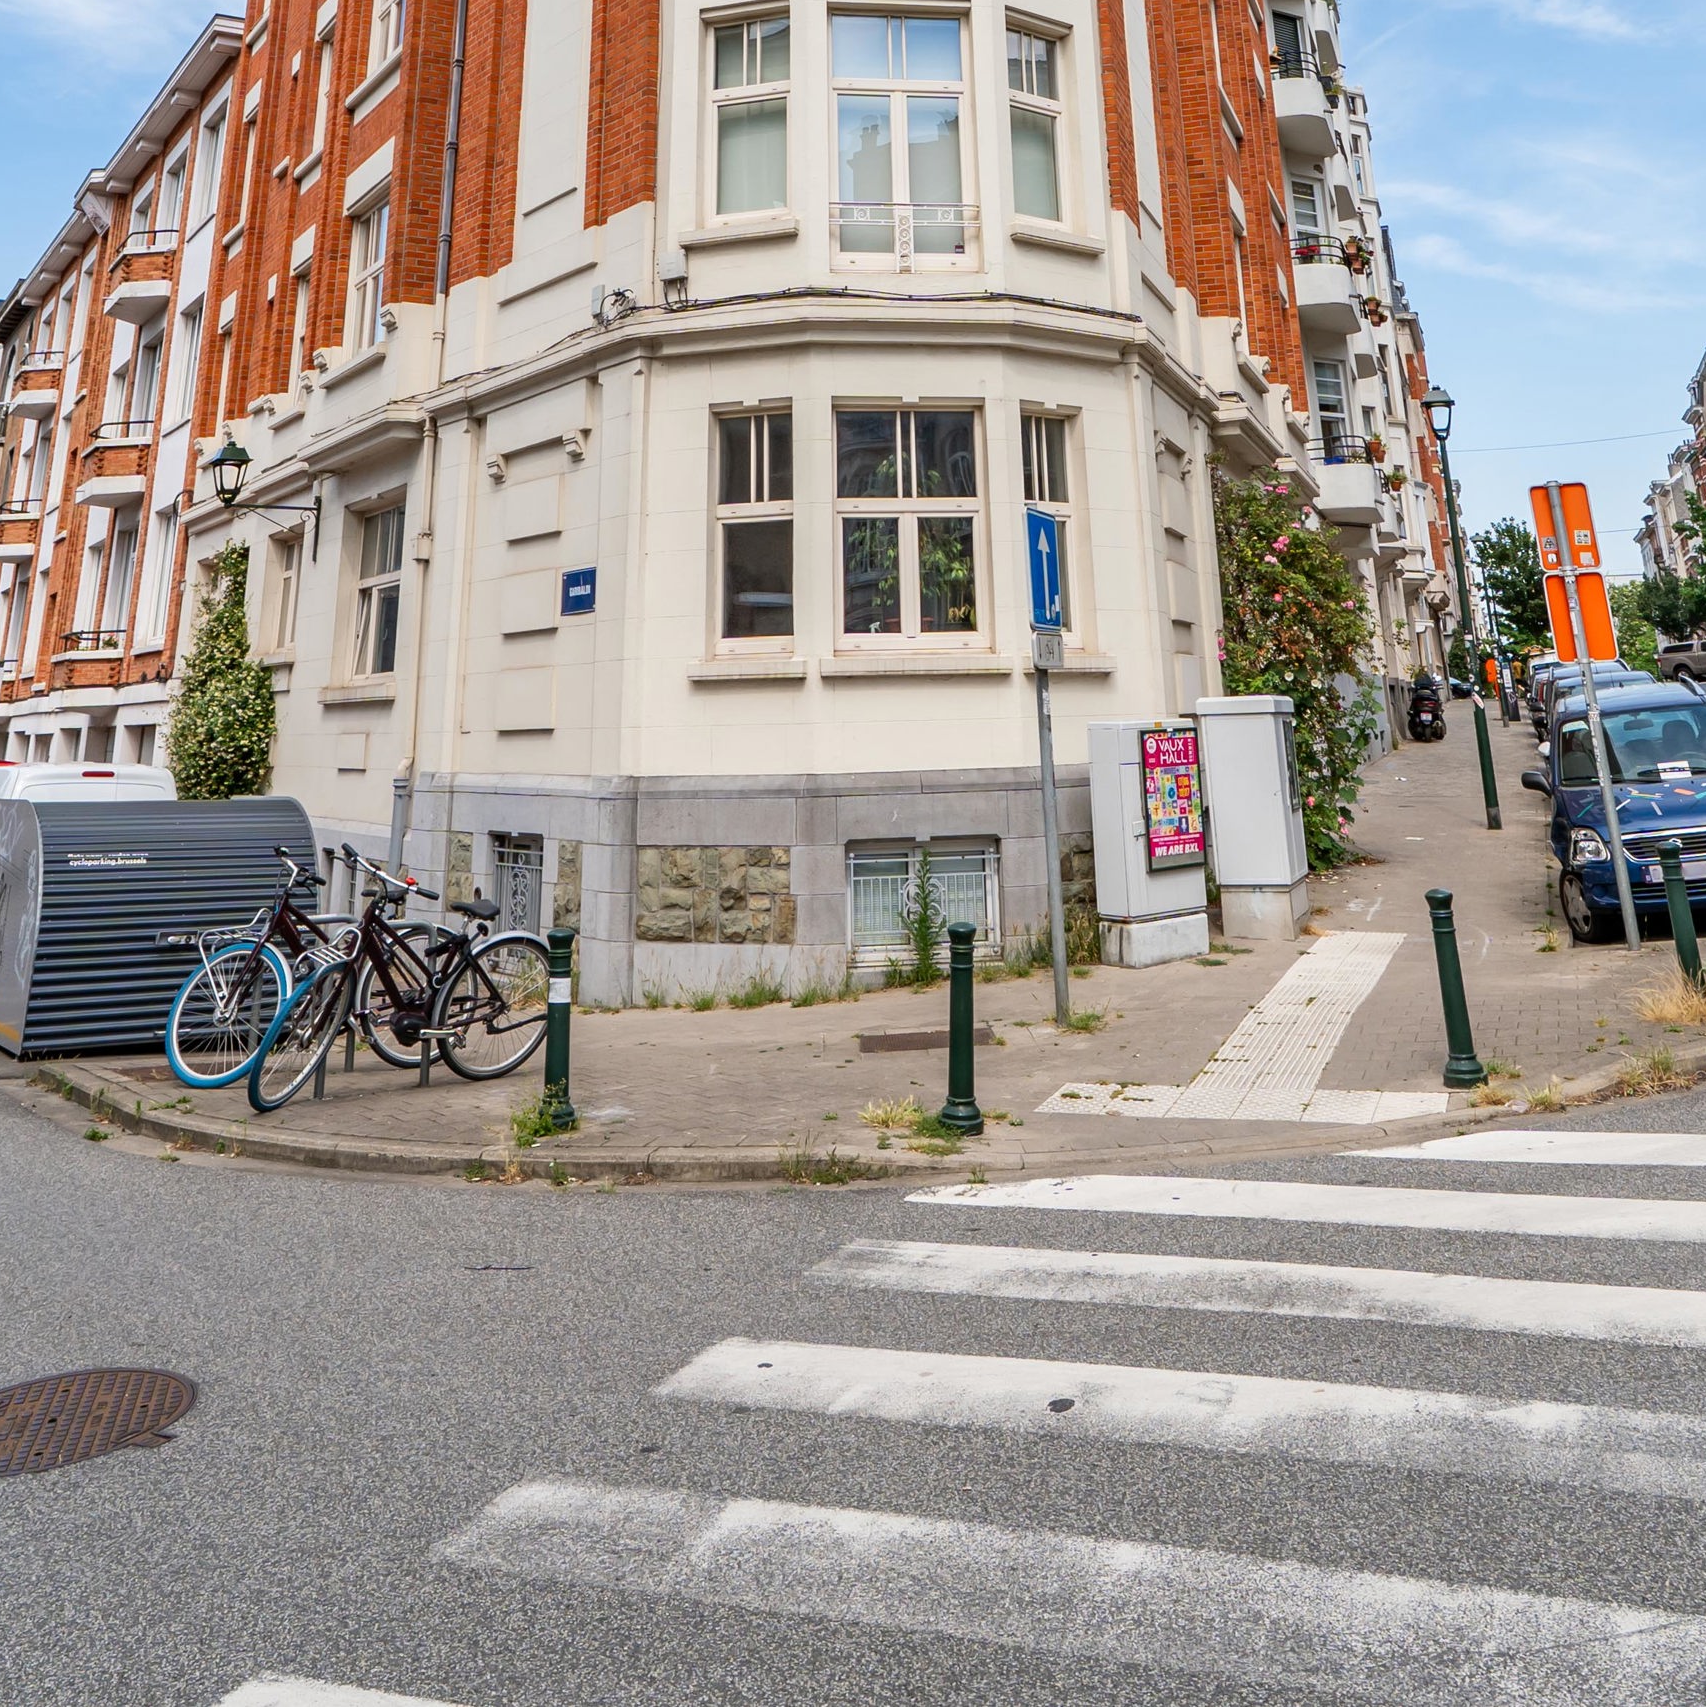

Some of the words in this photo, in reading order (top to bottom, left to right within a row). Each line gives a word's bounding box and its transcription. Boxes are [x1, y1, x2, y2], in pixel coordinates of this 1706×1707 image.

[1158, 739, 1184, 752] VAUX
[1160, 751, 1187, 764] HALL
[1155, 846, 1168, 857] WE
[1168, 844, 1184, 855] ARE
[1185, 843, 1199, 854] BXL
[69, 857, 147, 866] cycloparking.brussels
